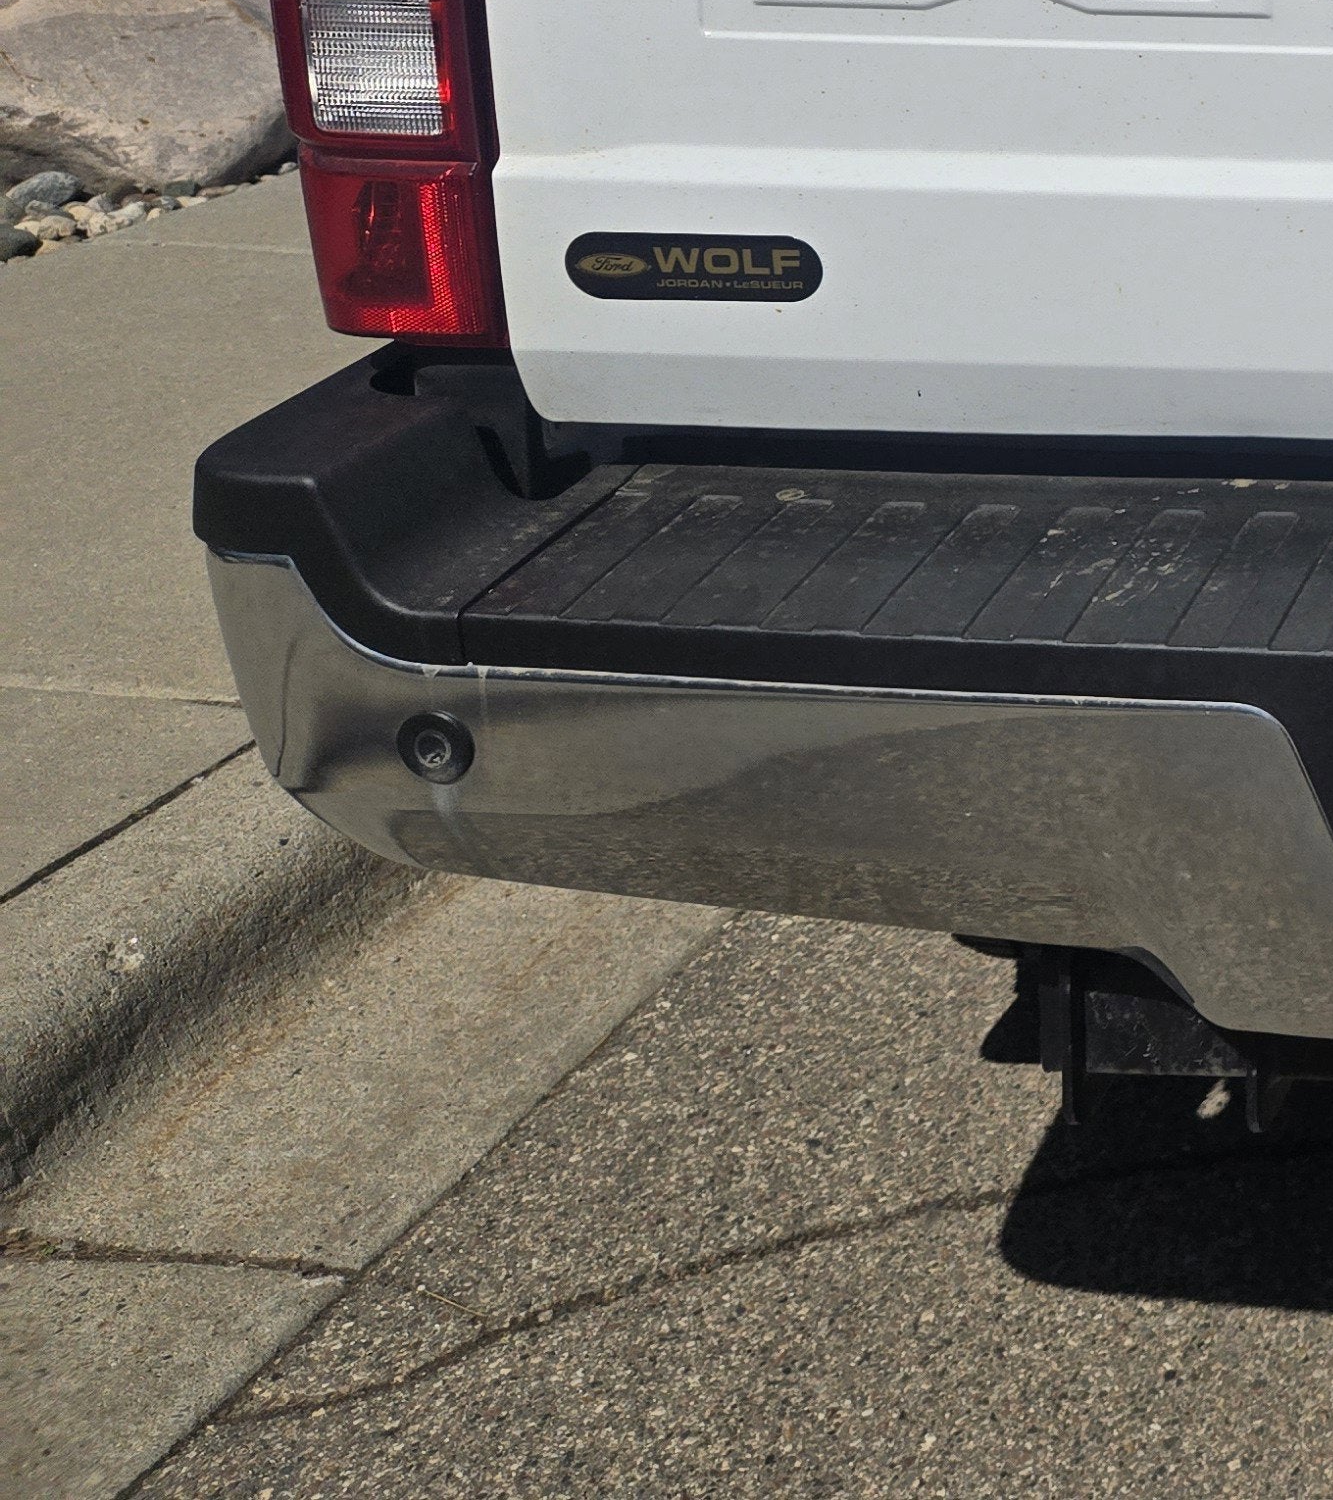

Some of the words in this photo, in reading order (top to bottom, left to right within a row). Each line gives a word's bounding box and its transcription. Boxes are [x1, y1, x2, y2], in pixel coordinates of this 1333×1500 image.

[592, 257, 633, 273] Ford
[653, 246, 800, 275] WOLF
[656, 278, 723, 288] JORDAN
